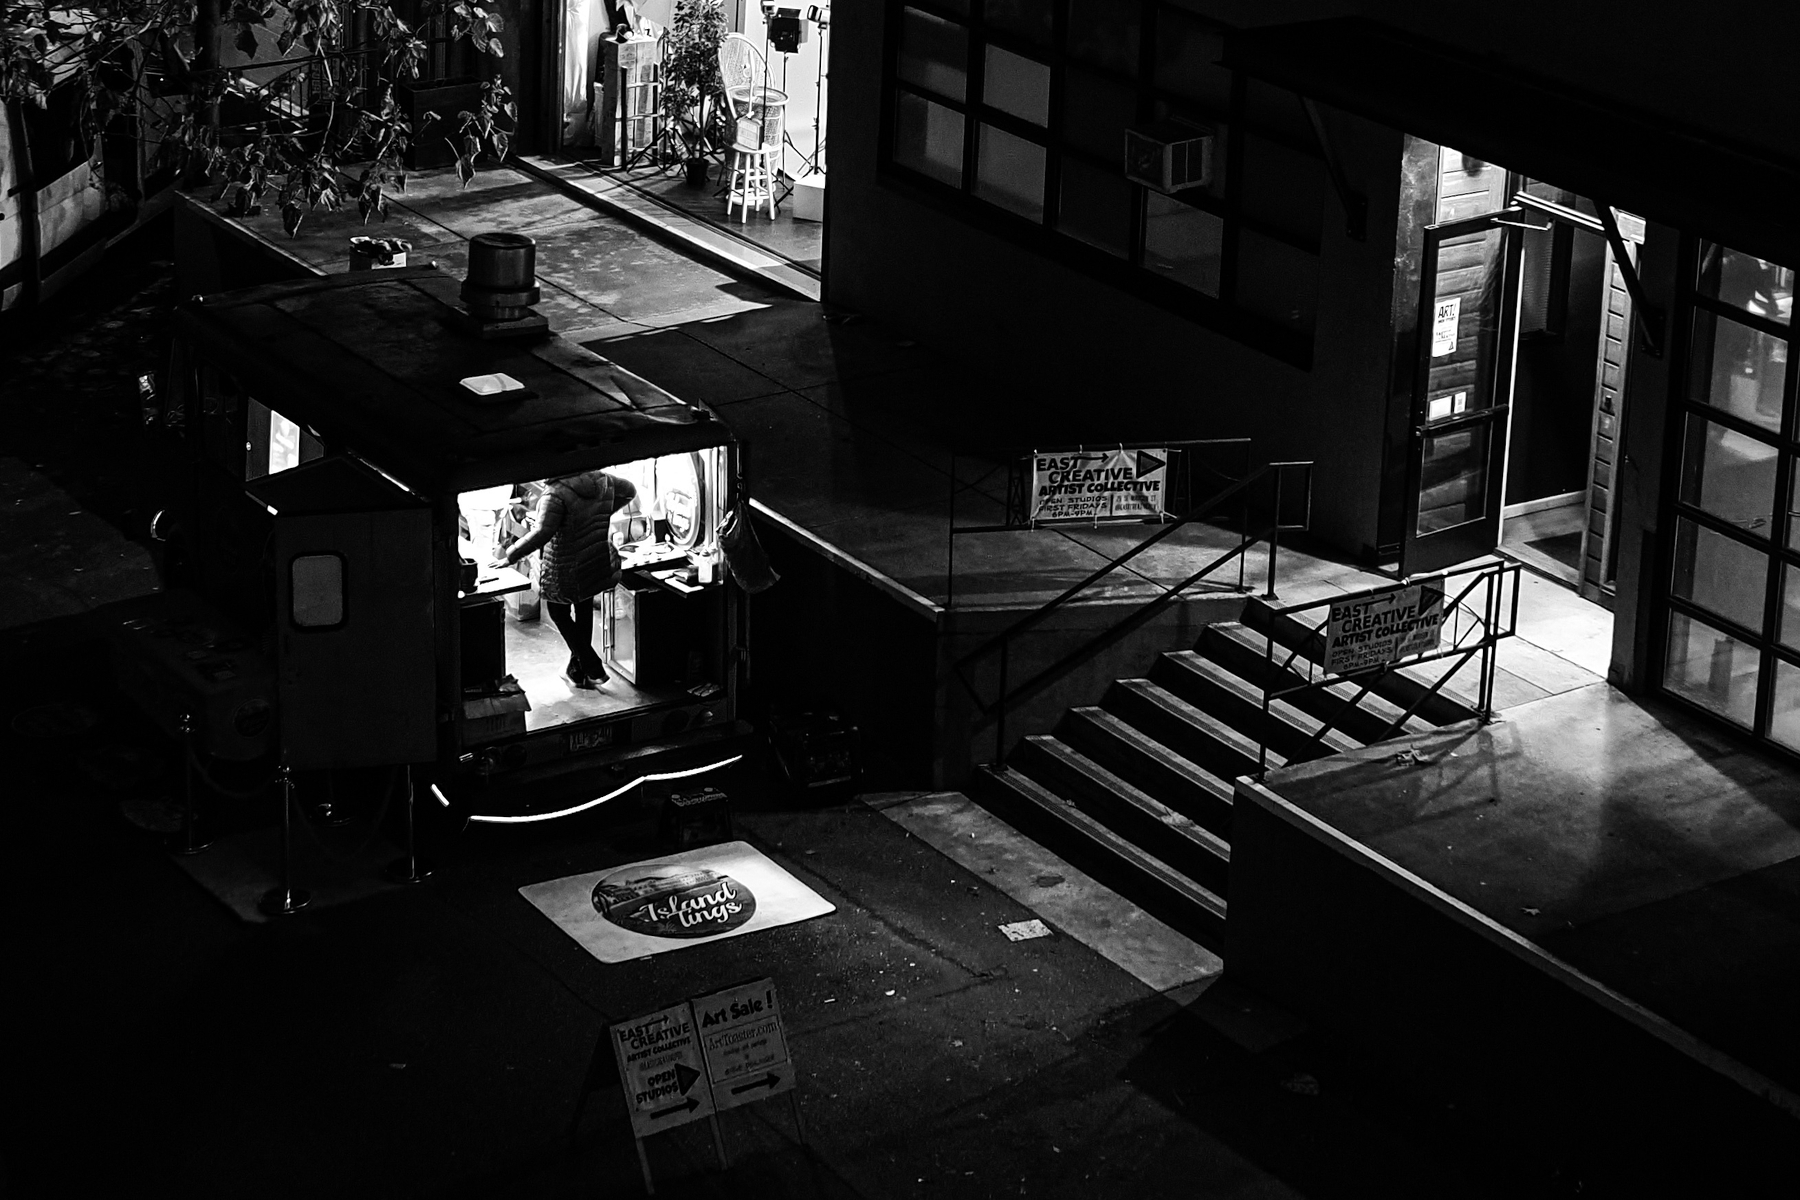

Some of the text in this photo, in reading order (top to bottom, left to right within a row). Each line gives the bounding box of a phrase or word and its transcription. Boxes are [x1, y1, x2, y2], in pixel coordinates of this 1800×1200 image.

[1037, 456, 1079, 471] EAST
[1049, 468, 1133, 484] CREATIVE
[1039, 481, 1160, 496] ARTIST COLLECTIVE
[1068, 496, 1107, 504] STUDIOS
[1068, 503, 1107, 511] FRIDAYS
[1052, 510, 1093, 518] 6PM-9PM
[1332, 604, 1369, 622] EAST
[1342, 605, 1416, 633] CREATIVE
[1332, 630, 1373, 648] ARTIST
[1376, 614, 1439, 639] COLLECTIVE
[1332, 649, 1354, 659] OPEN
[1358, 640, 1393, 653] STUDIOS
[1332, 655, 1356, 666] FIRST
[639, 882, 737, 922] Island
[702, 1008, 728, 1028] Art
[619, 1024, 650, 1043] EAST
[631, 1022, 691, 1050] CREATIVE
[708, 1021, 778, 1051] ArtToaster.com
[627, 1050, 652, 1063] ARTIST
[653, 1036, 691, 1055] COLLECTIVE
[647, 1069, 676, 1087] OPEN
[635, 1081, 679, 1104] STUDIOS
